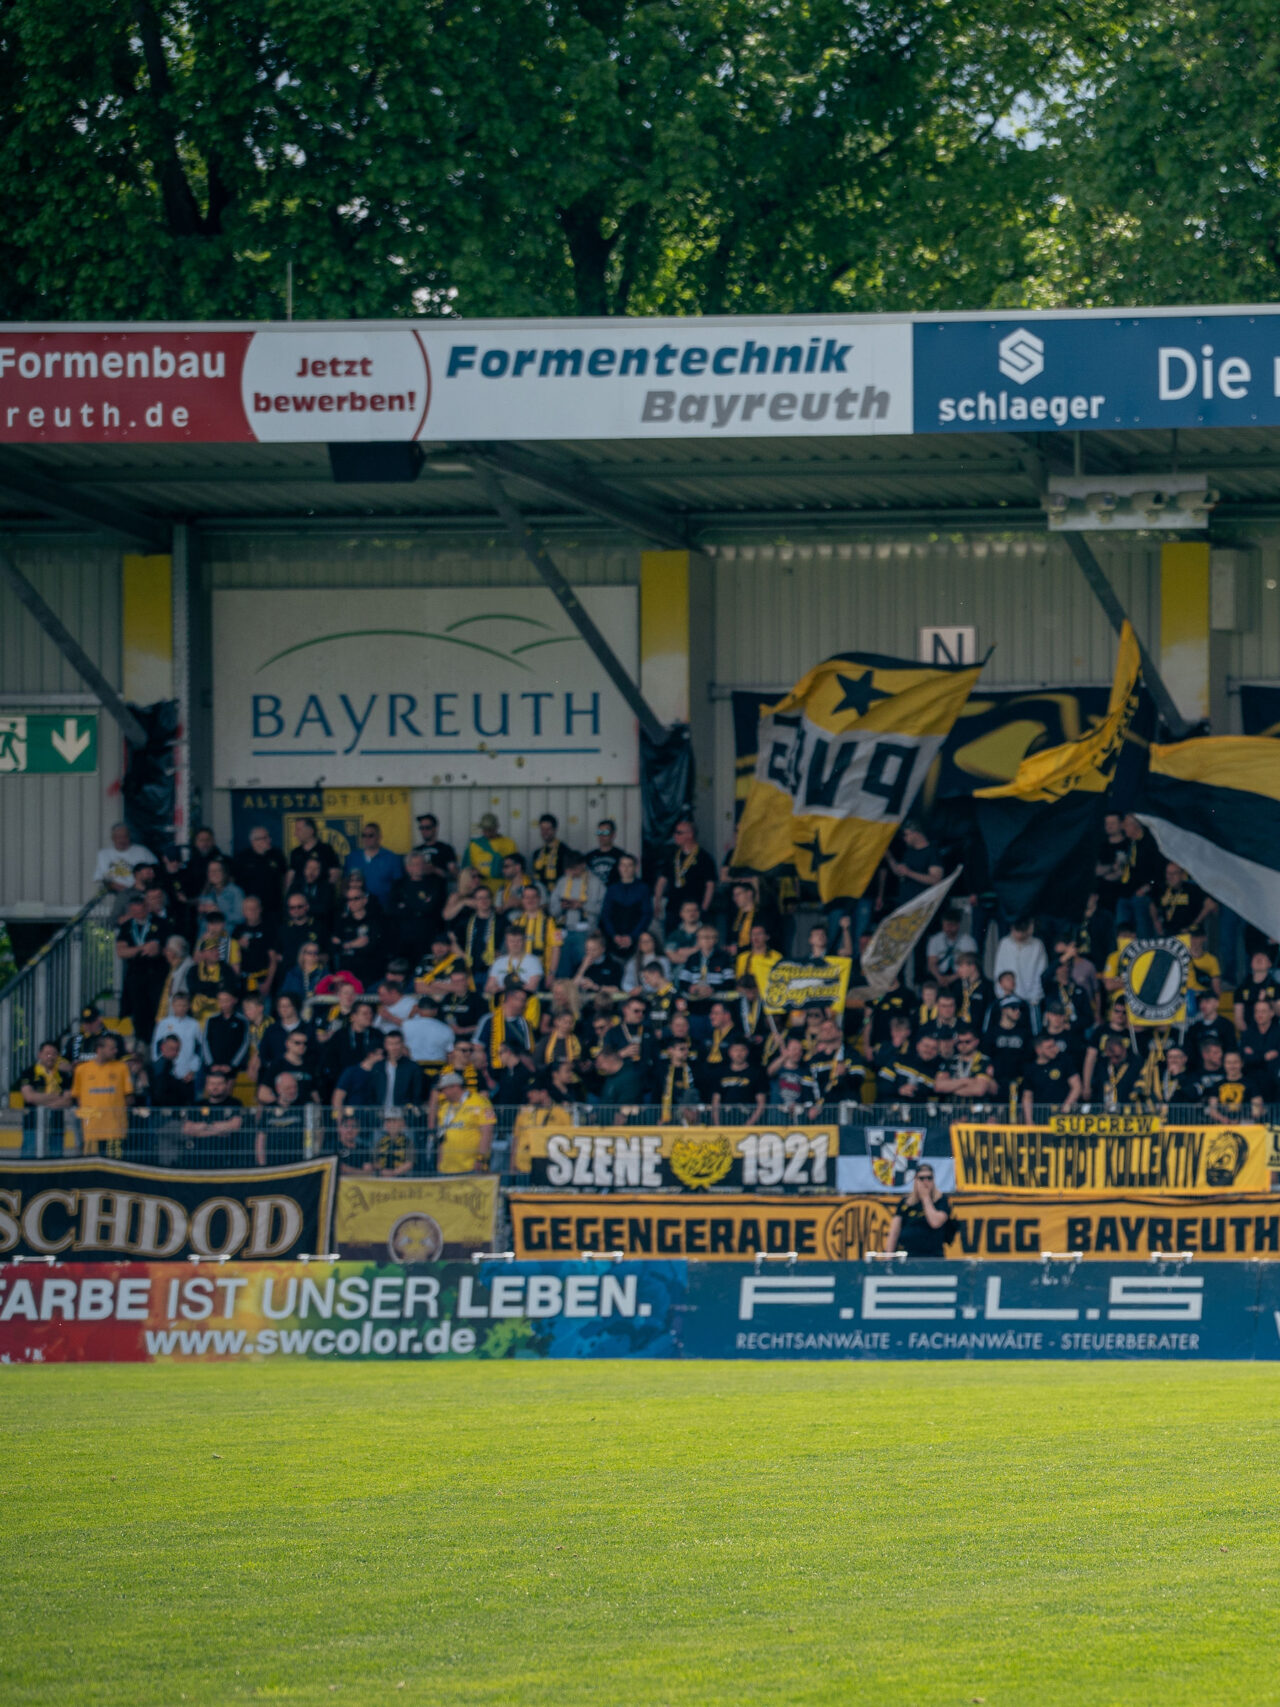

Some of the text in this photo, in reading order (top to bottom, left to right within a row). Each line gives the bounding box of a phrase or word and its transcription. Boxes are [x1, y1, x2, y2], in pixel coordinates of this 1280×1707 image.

[0, 346, 226, 379] Formenbau
[296, 356, 373, 378] Jetzt
[446, 337, 853, 379] Formentechnik
[1158, 345, 1251, 400] Die
[253, 391, 416, 413] bewerben!
[641, 386, 891, 430] Bayreuth
[938, 392, 1106, 427] schlaeger
[251, 690, 601, 756] BAYREUTH
[1055, 1116, 1154, 1135] SUPCREW
[546, 1132, 829, 1188] SZENE 1921
[521, 1215, 818, 1254] GEGENGERADE
[1067, 1215, 1280, 1253] BAYREUTH
[0, 1274, 653, 1321] ARBE IST UNSER LEBEN.
[145, 1319, 476, 1357] www.swcolor.de
[736, 1329, 891, 1351] RECHTSANWÄLTE
[908, 1330, 1043, 1351] FACHANWÄLTE
[1060, 1332, 1200, 1352] STEUERBERATER
